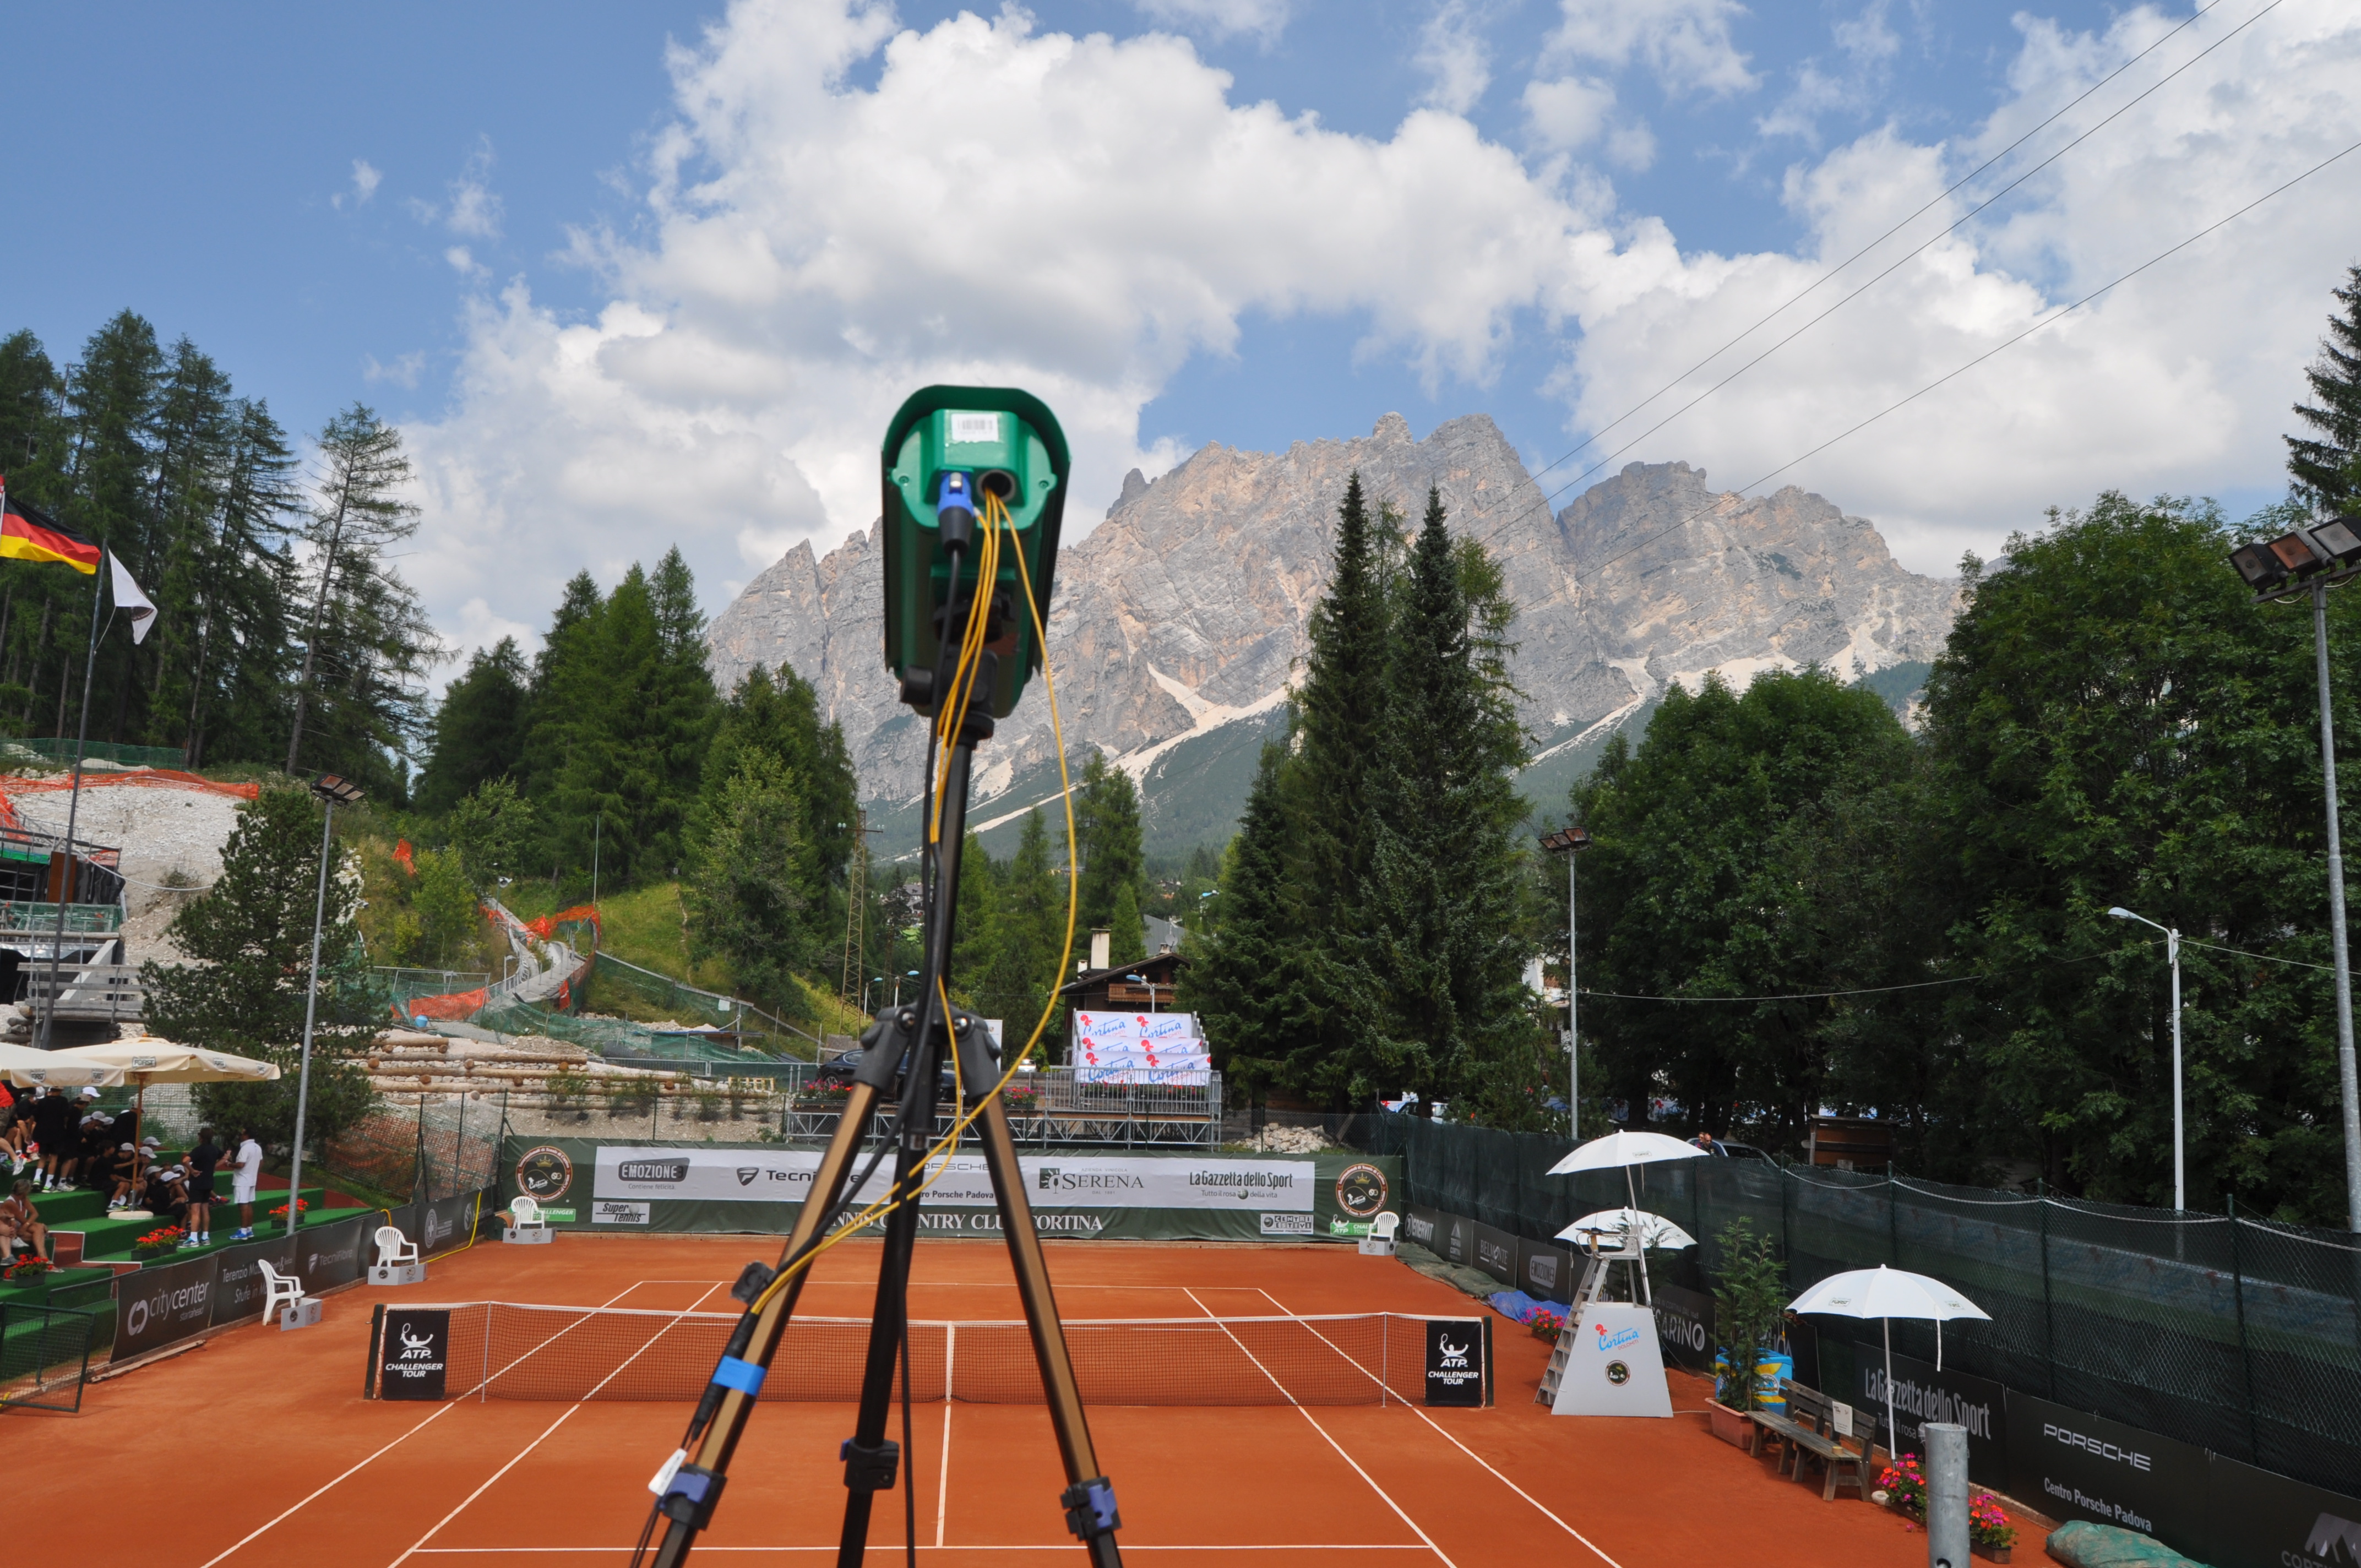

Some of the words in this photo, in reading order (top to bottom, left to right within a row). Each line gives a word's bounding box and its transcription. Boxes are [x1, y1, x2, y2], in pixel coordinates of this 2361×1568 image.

[1088, 1057, 1135, 1081] Cortina
[1149, 1059, 1195, 1083] Cortina
[766, 1170, 861, 1183] Tecnie
[1062, 1173, 1144, 1190] SERENA
[1244, 1172, 1266, 1187] dello
[1267, 1172, 1293, 1190] Sport
[932, 1190, 964, 1199] Porsche
[603, 1202, 629, 1214] Super
[614, 1213, 641, 1223] Tennis
[832, 1211, 874, 1228] NNIS
[879, 1212, 966, 1229] CNTRY
[971, 1214, 1004, 1230] CLU
[1033, 1215, 1103, 1231] ORTINA
[1412, 1218, 1434, 1242] ENERVIT
[319, 1249, 353, 1266] TecniFibre
[1480, 1239, 1509, 1265] BELMONTE
[222, 1264, 247, 1283] Terenzio
[149, 1281, 209, 1321] citycenter
[235, 1285, 250, 1304] Stufe
[252, 1283, 259, 1298] in
[1598, 1327, 1639, 1352] Cortina
[1618, 1339, 1639, 1351] DOLOMITI
[399, 1349, 432, 1359] ATP
[1440, 1358, 1468, 1368] ATP
[1924, 1384, 1952, 1423] dello
[1954, 1393, 1991, 1440] Sport
[1901, 1424, 1917, 1440] rosa
[2044, 1423, 2151, 1472] PORSCHE
[2044, 1477, 2072, 1502] Centro
[2074, 1488, 2112, 1517] Porsche
[2114, 1504, 2152, 1533] Padova
